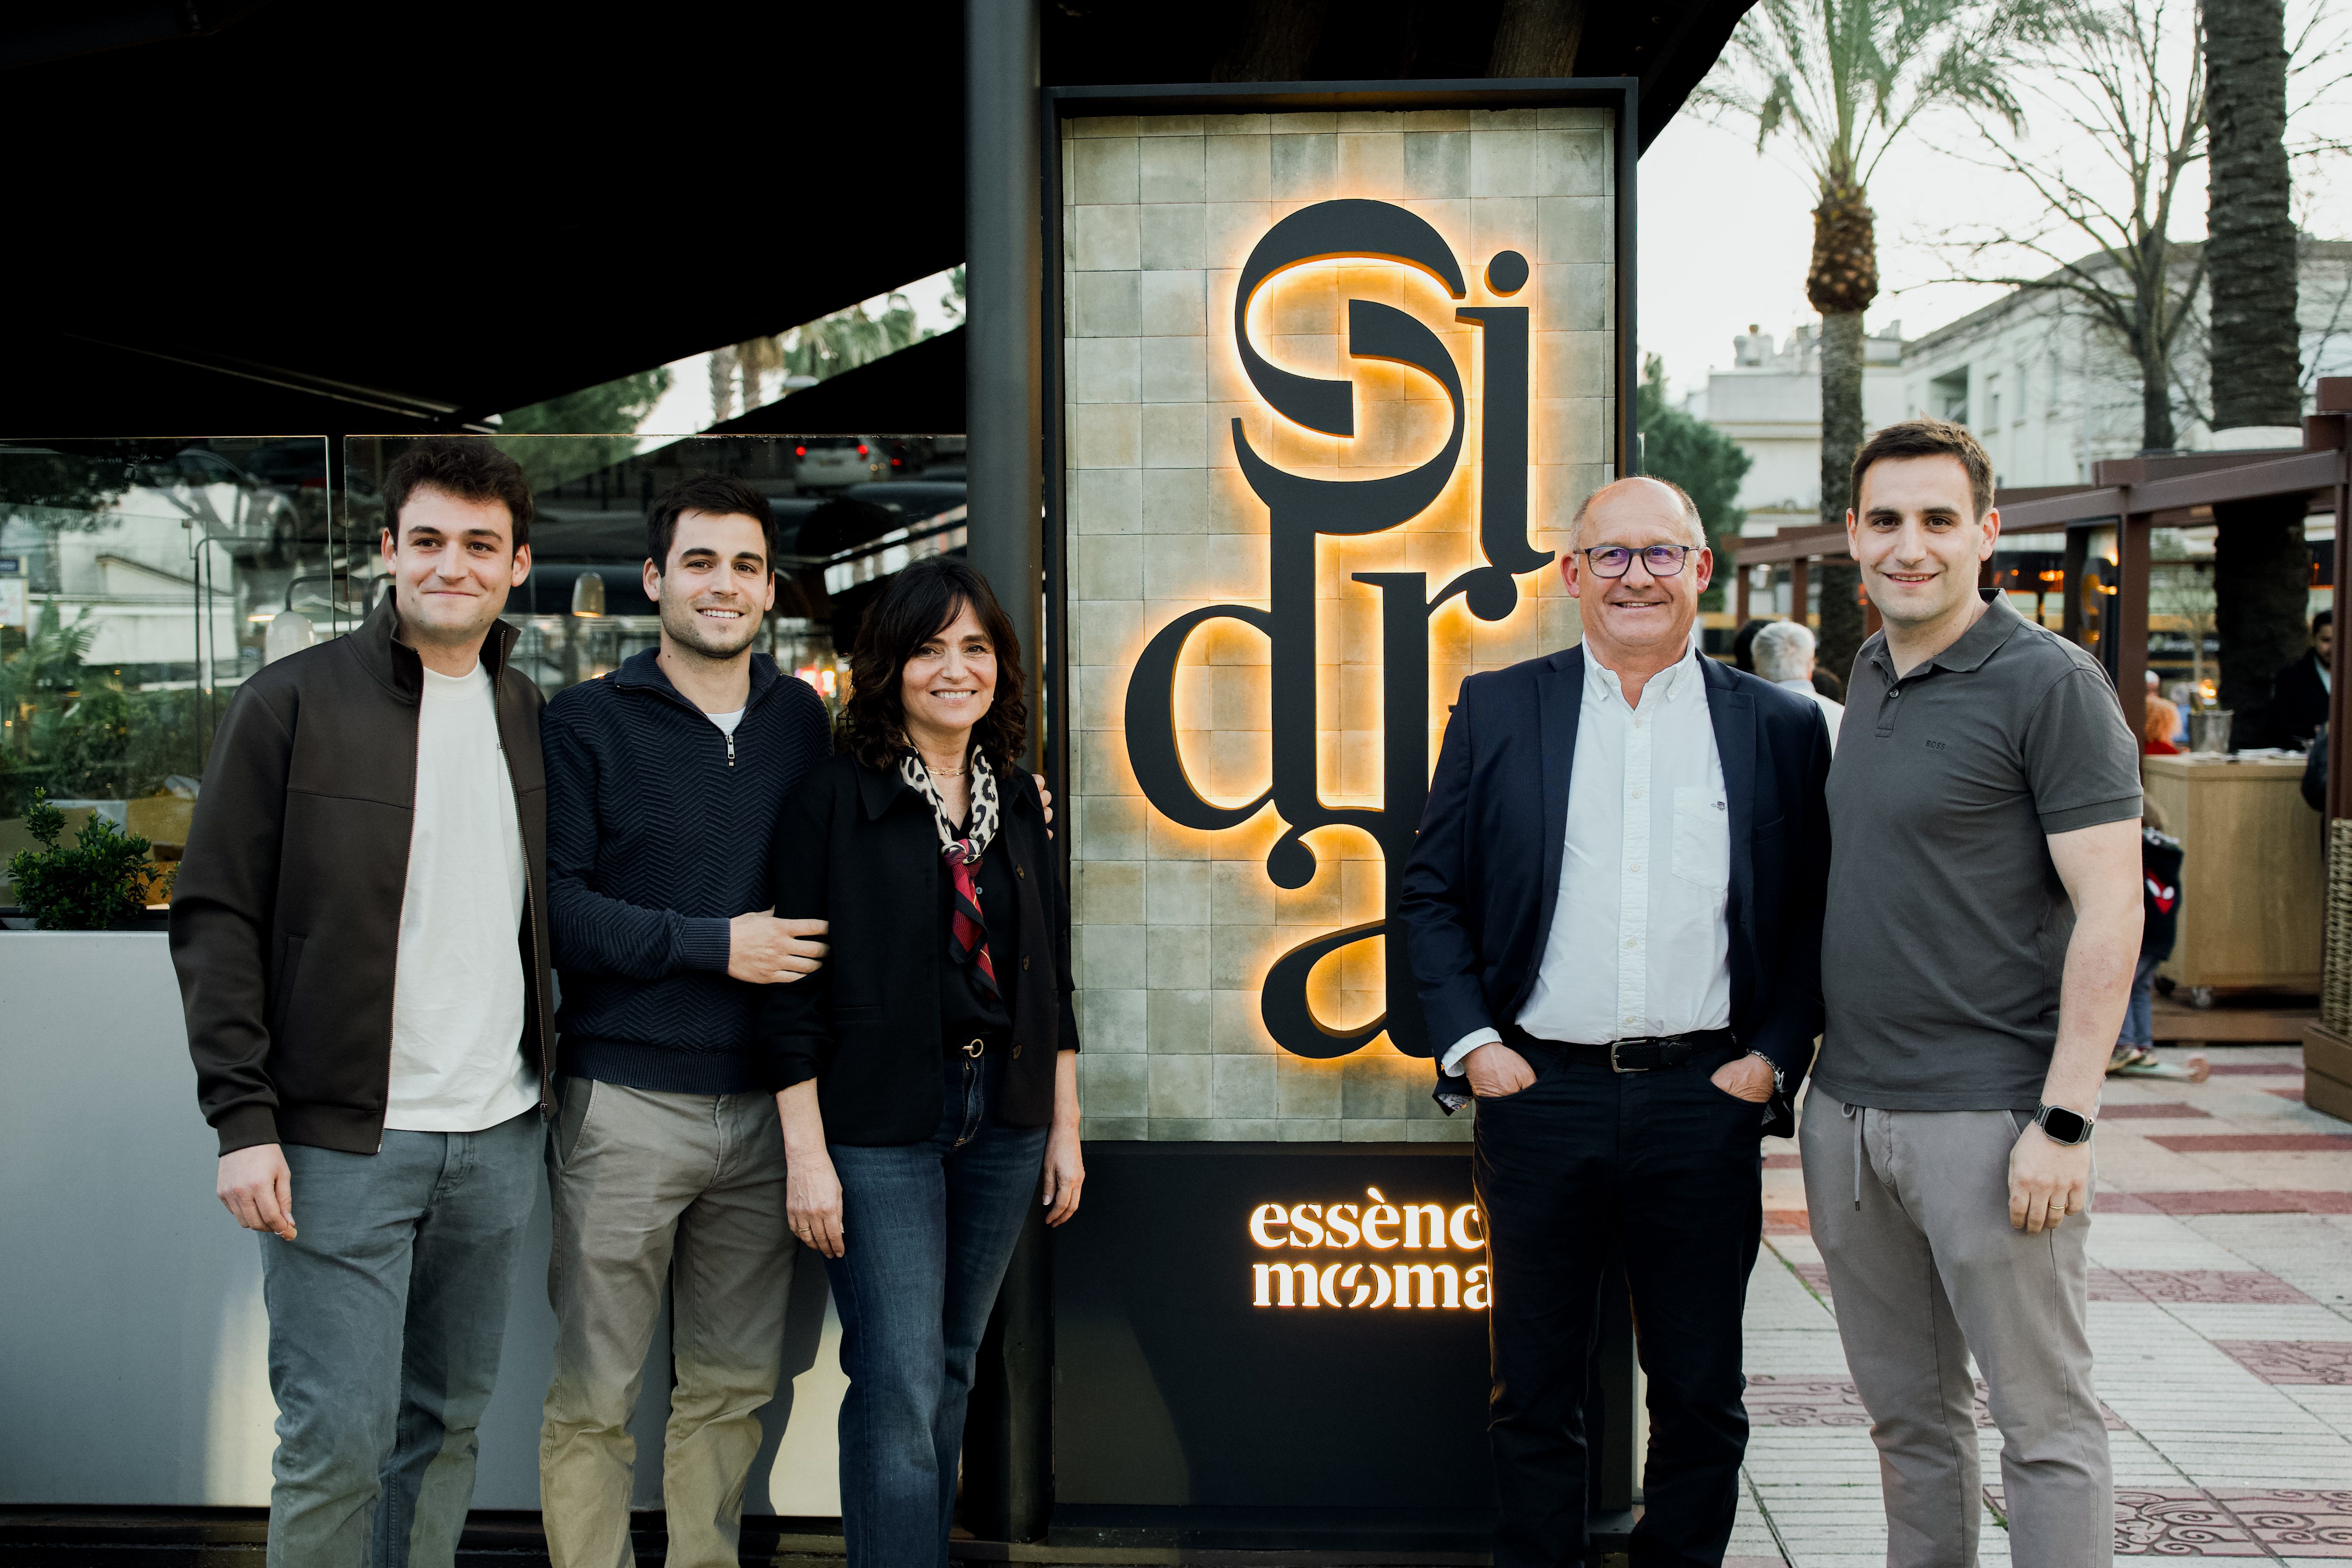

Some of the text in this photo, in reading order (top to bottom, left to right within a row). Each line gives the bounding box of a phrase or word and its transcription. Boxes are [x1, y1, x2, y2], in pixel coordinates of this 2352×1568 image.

[1925, 739, 1946, 750] BOSS
[1249, 1186, 1485, 1250] essènc
[1252, 1263, 1492, 1310] mooma
